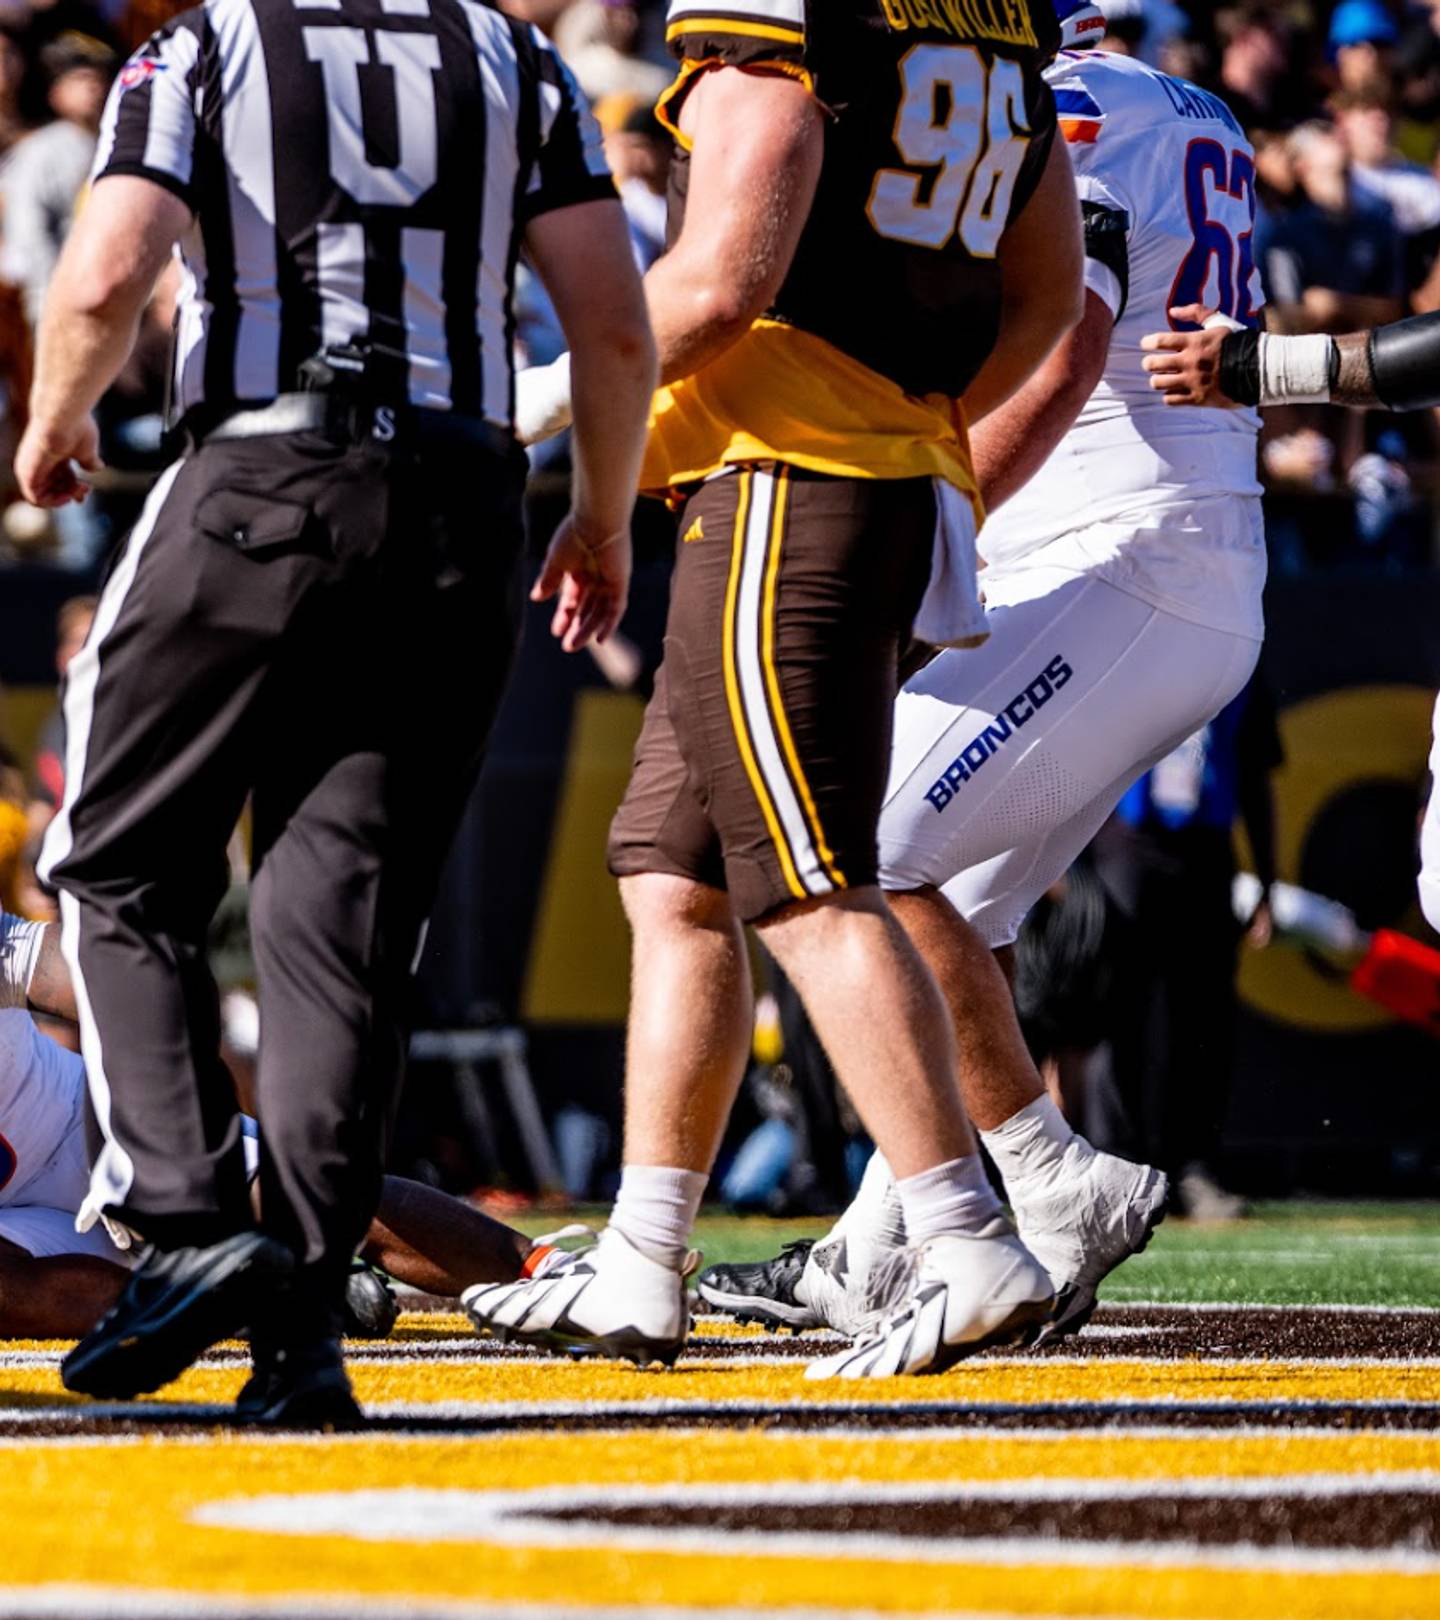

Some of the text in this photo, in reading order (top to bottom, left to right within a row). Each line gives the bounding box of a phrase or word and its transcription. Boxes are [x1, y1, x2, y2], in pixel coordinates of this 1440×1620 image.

[302, 26, 442, 207] U
[865, 42, 1032, 260] 96
[1166, 137, 1259, 332] 62
[372, 406, 395, 441] S
[924, 654, 1073, 813] BRONCOS
